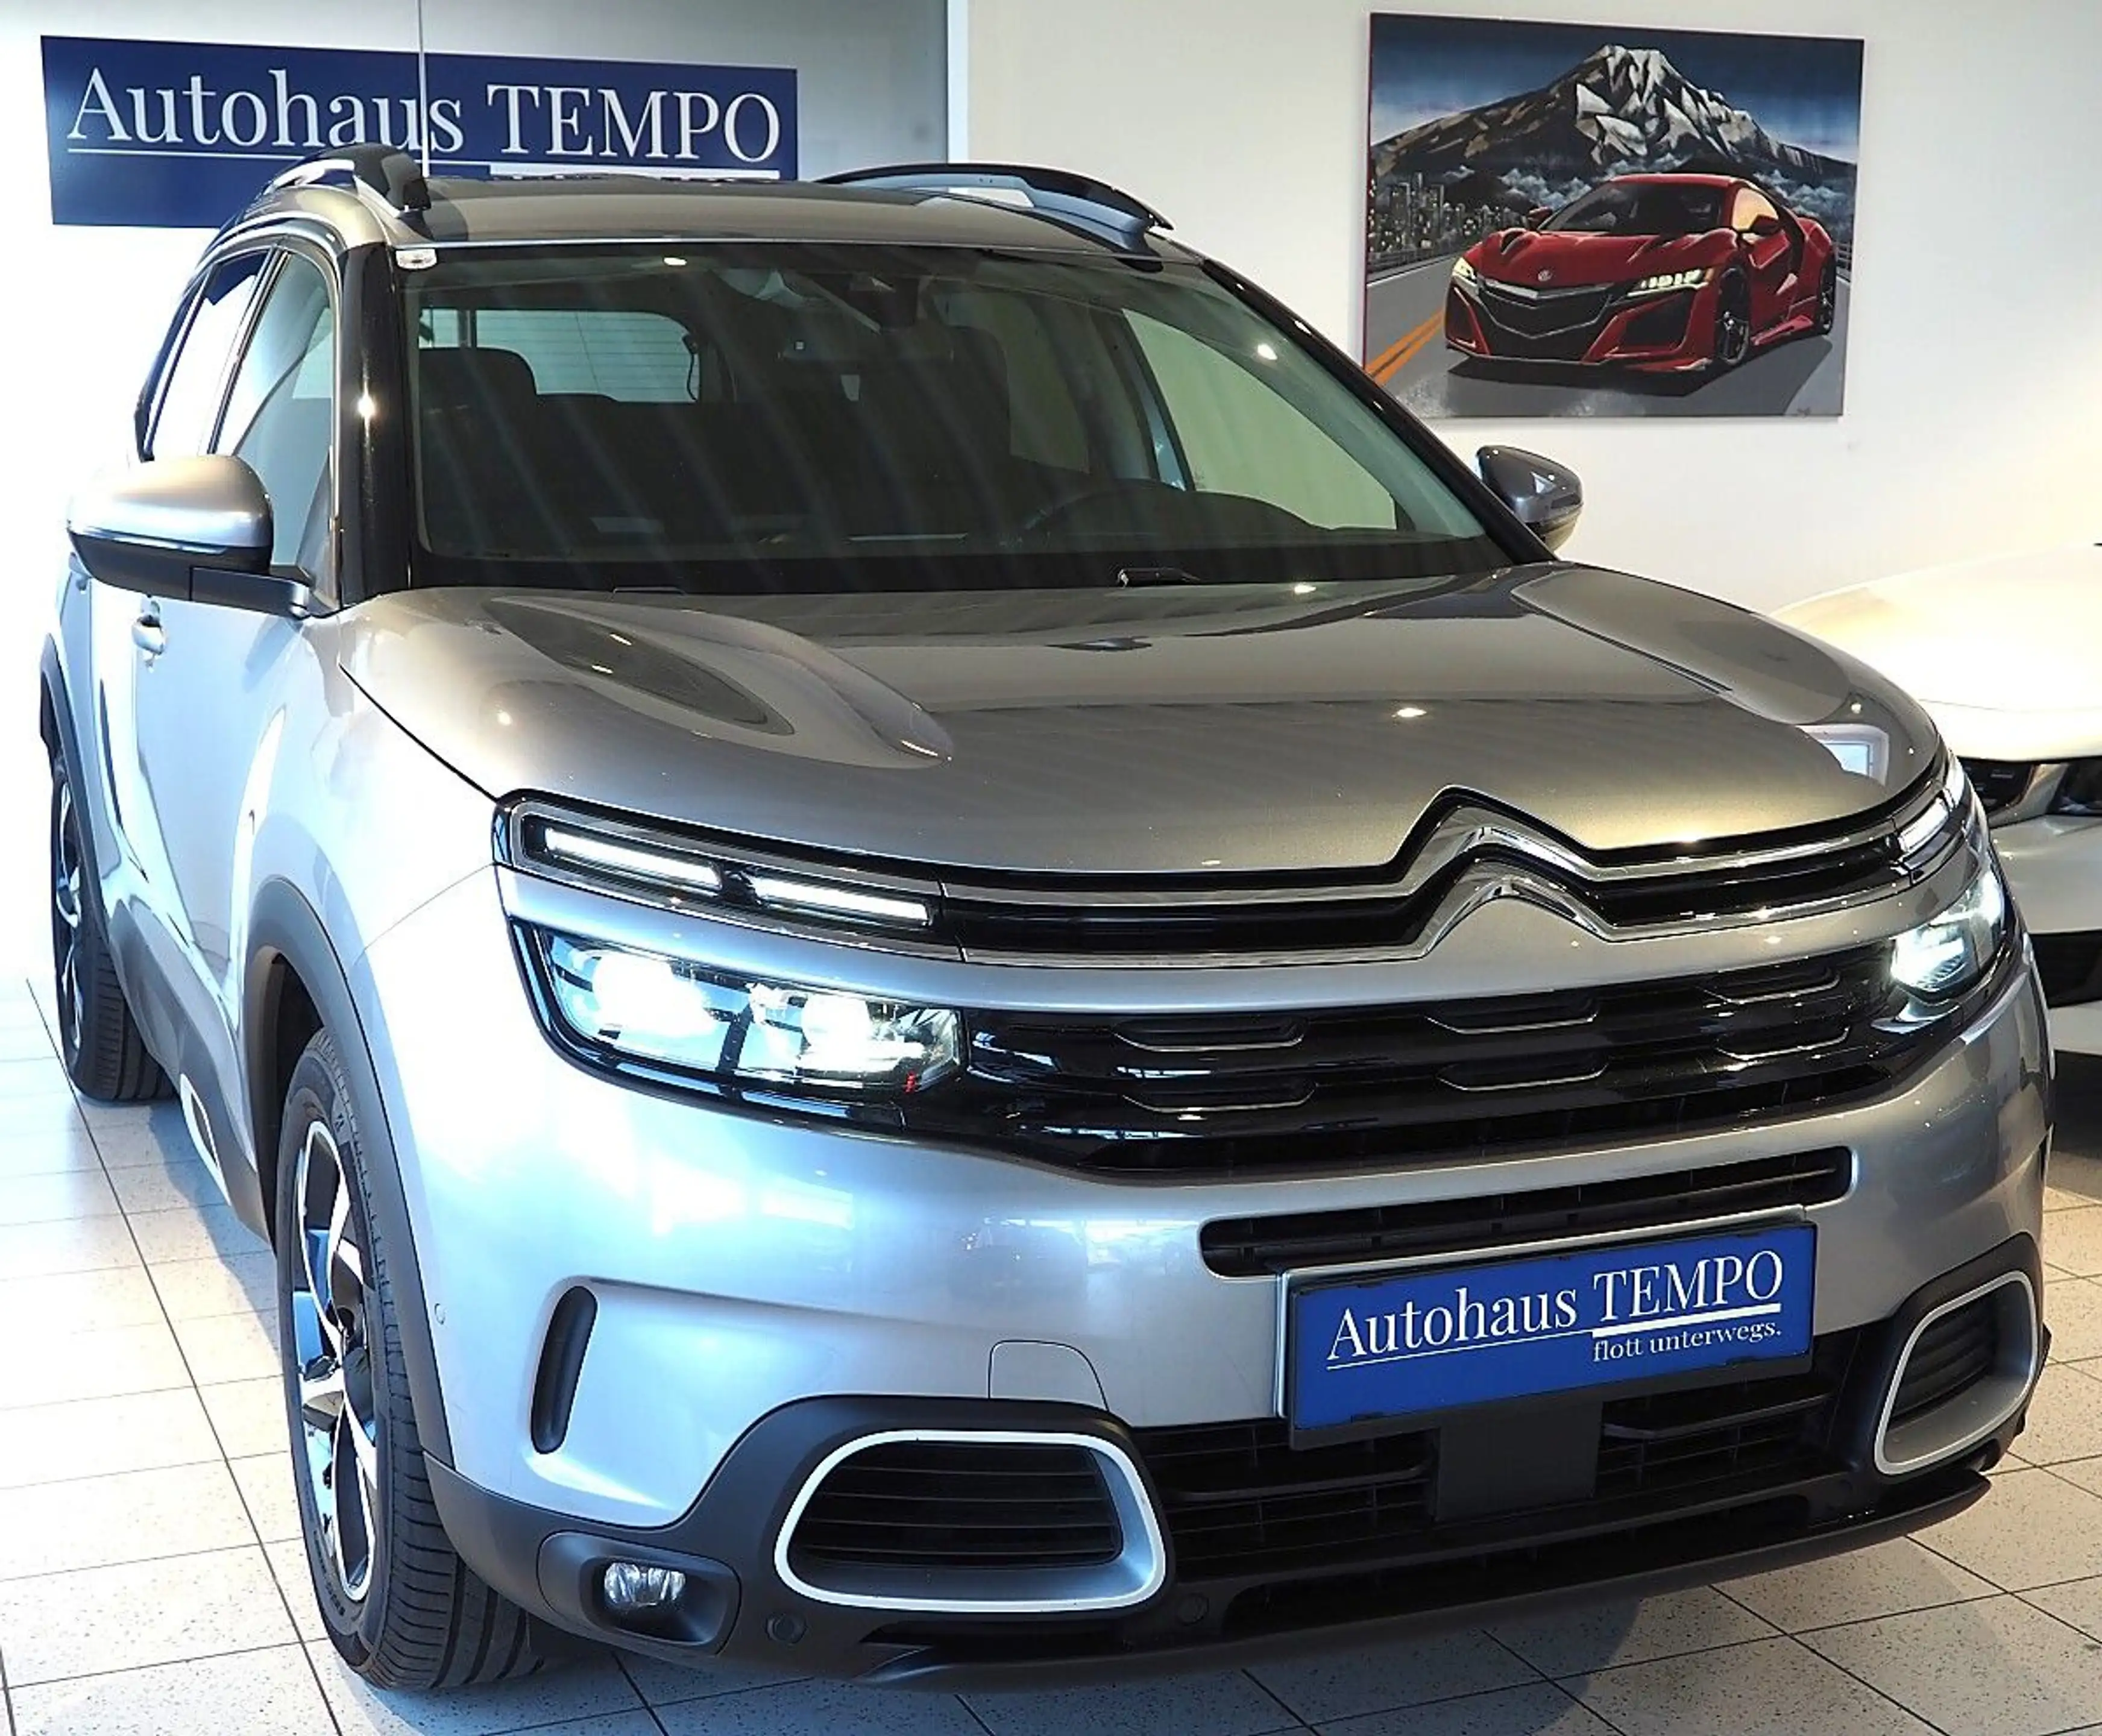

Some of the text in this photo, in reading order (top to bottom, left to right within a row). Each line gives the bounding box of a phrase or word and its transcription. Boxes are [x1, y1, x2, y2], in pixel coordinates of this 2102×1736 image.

[68, 68, 781, 163] Autohaus TEMPO
[1327, 1250, 1783, 1360] Autohaus TEMPO
[1593, 1321, 1783, 1363] flott unterwegs.
